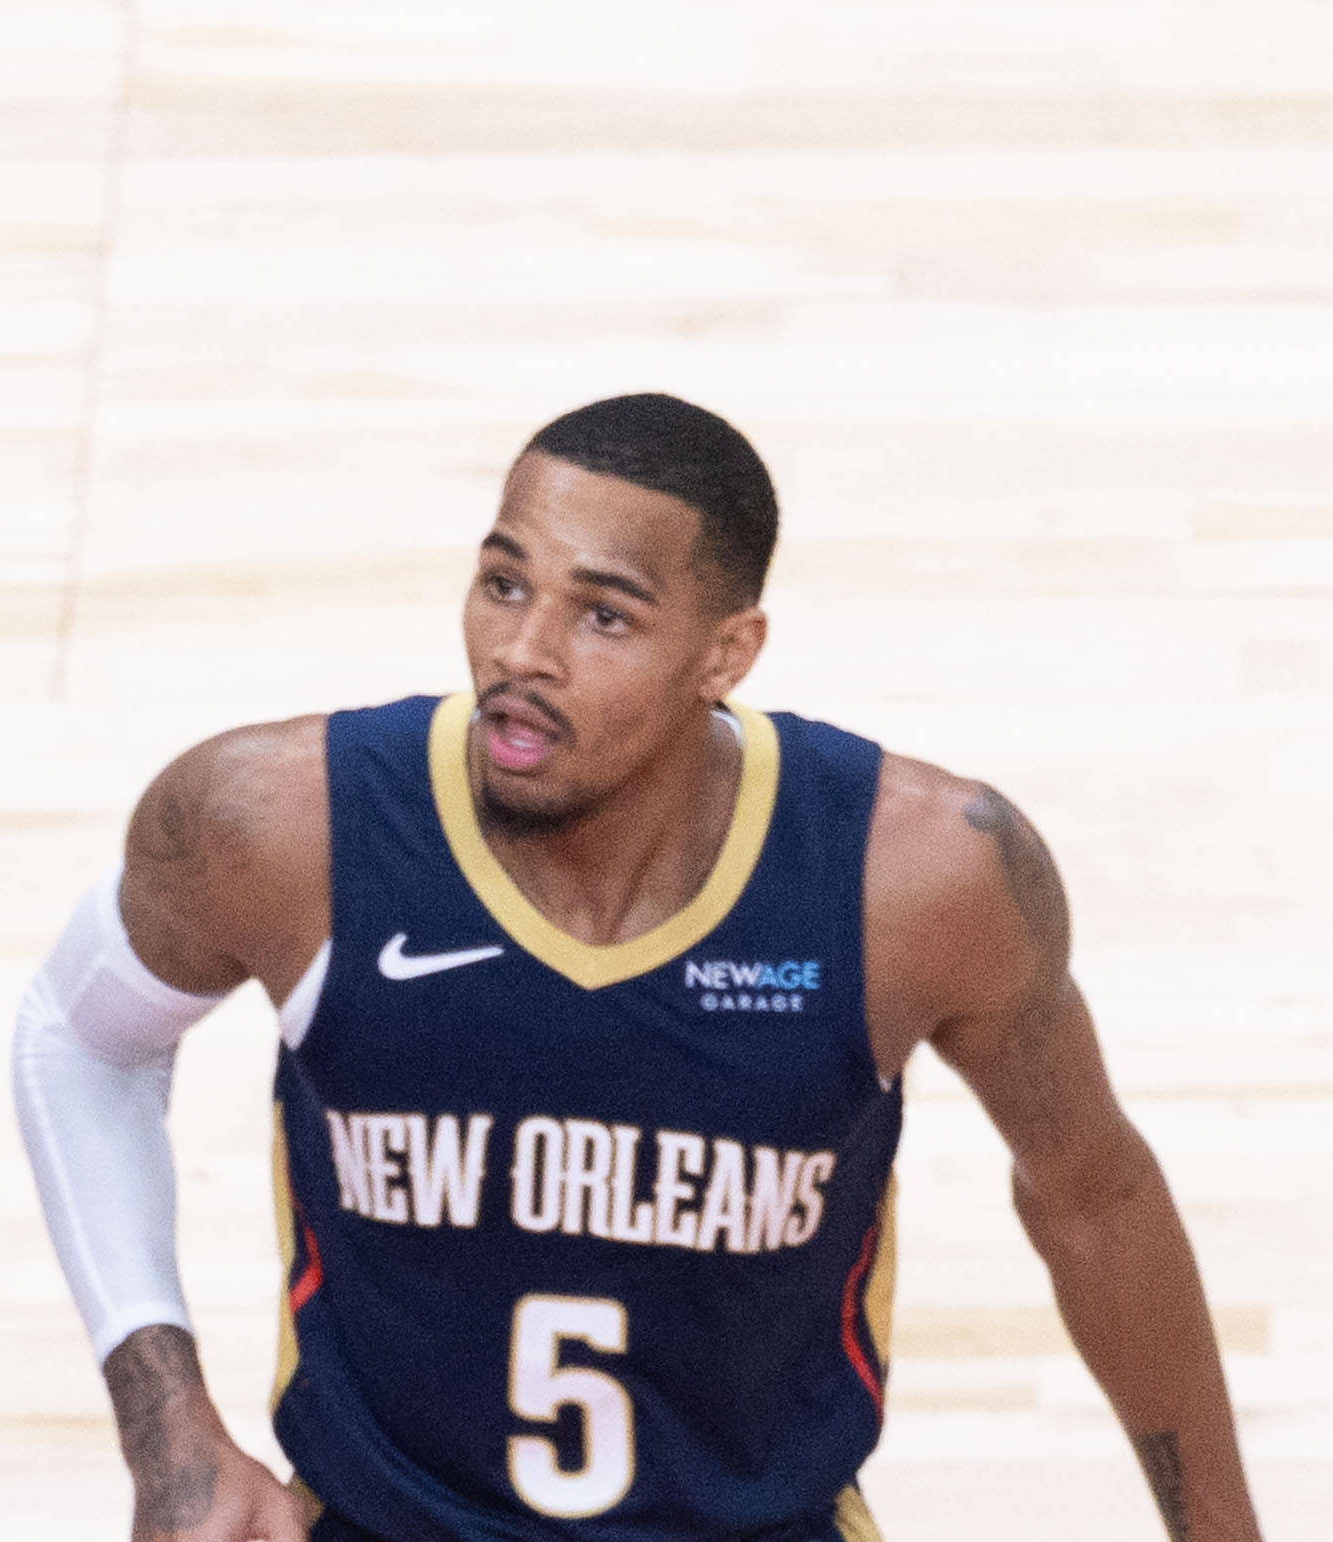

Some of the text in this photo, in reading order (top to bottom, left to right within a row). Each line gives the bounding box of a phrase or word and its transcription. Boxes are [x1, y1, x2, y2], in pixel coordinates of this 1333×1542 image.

[700, 993, 803, 1012] GARAGE
[327, 1110, 836, 1254] NEW ORLEANS
[506, 1293, 635, 1519] 5
